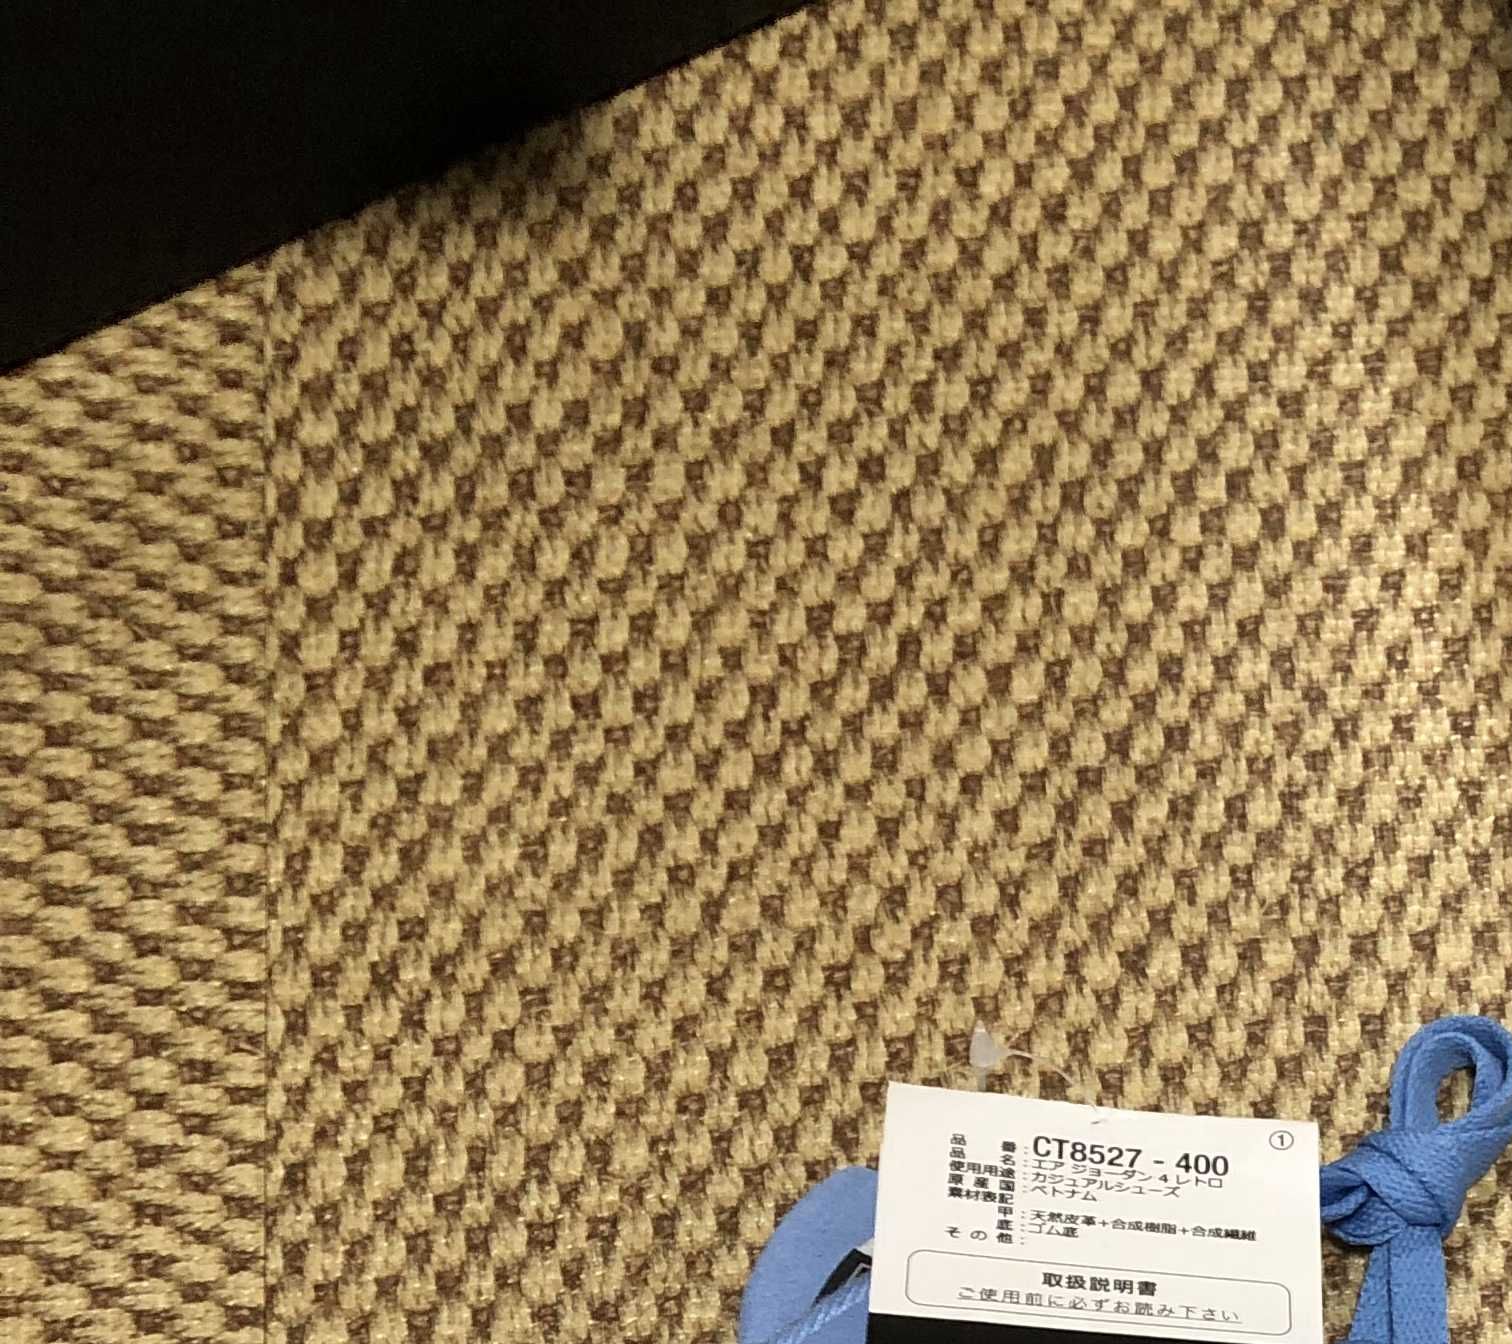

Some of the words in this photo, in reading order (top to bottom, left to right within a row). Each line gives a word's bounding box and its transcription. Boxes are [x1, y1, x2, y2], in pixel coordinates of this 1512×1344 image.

[1033, 1135, 1142, 1169] CT8527
[1175, 1152, 1229, 1177] 400
[1042, 1271, 1158, 1297] 取扱説明書
